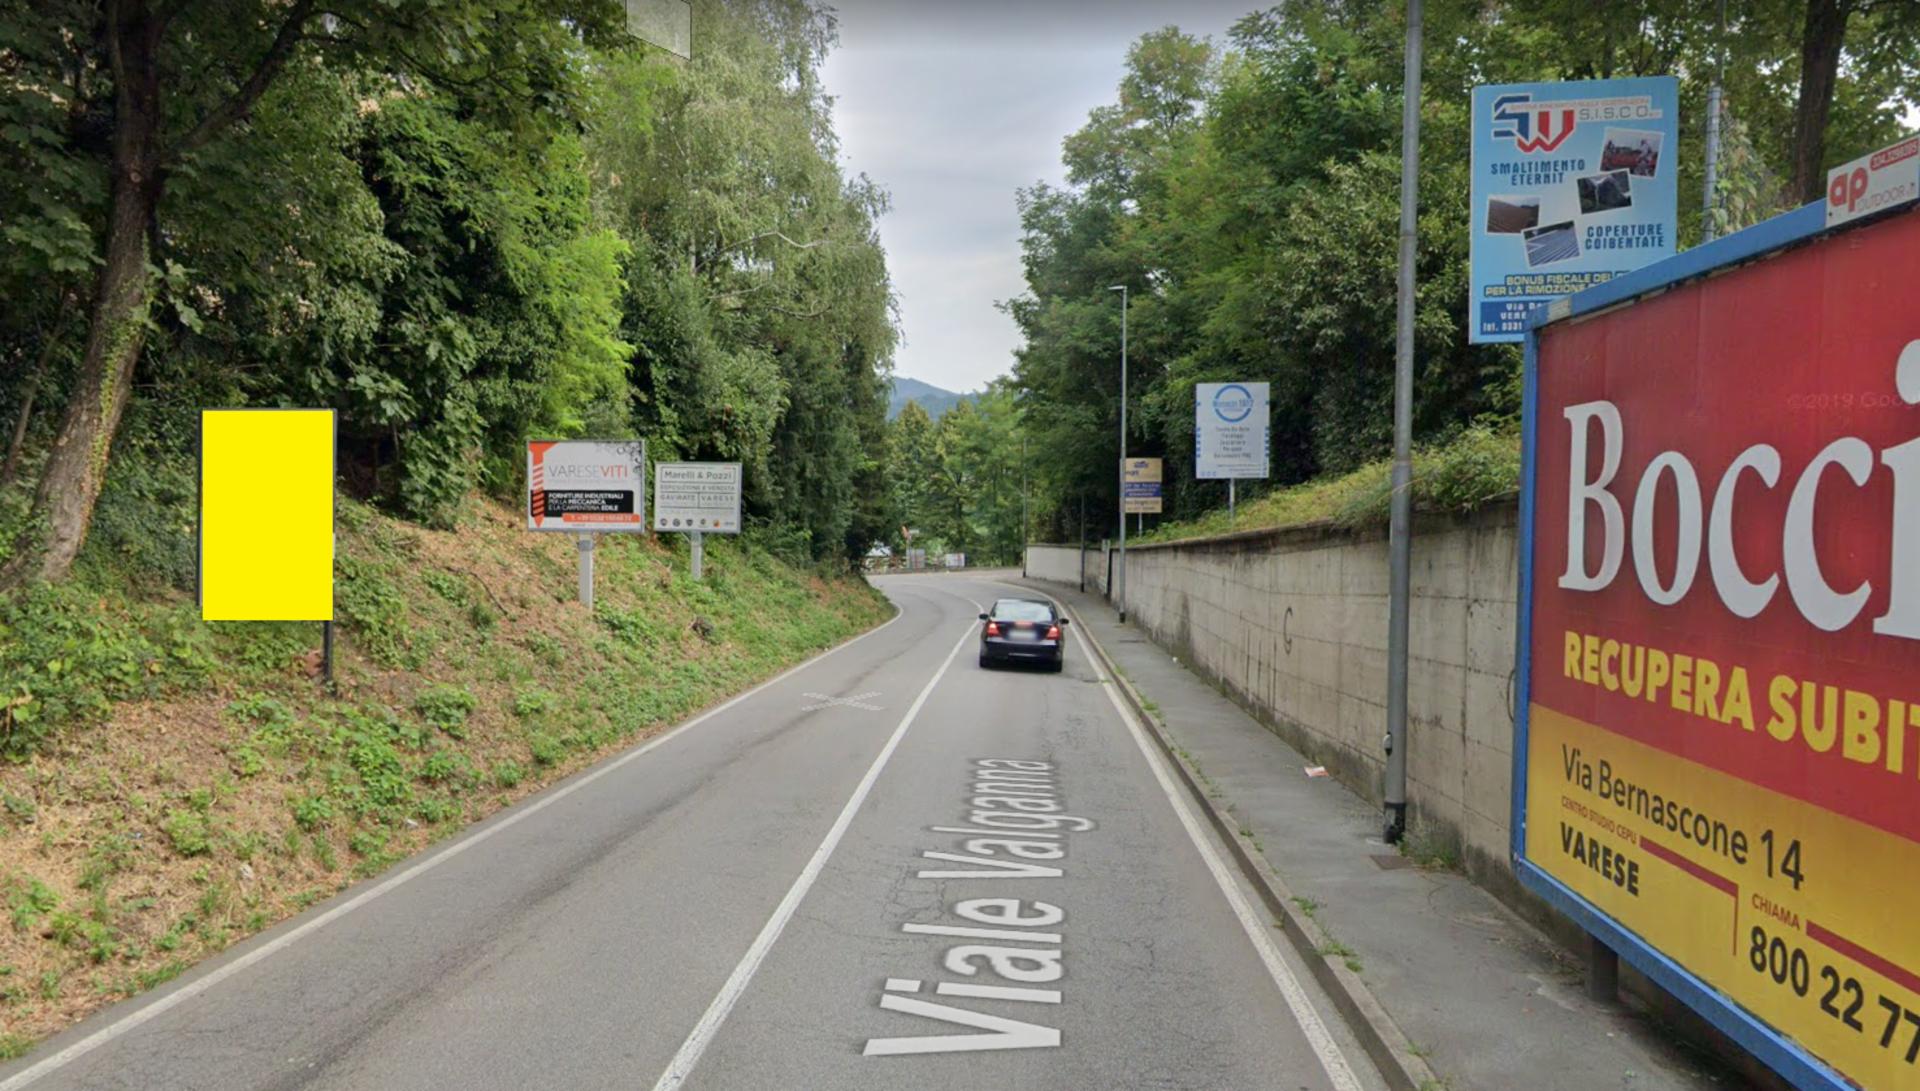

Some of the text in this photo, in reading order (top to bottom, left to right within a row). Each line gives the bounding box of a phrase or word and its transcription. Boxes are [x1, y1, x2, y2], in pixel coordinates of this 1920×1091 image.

[1490, 158, 1586, 175] SMALTIMENTO
[1511, 172, 1565, 187] ETERNIT
[1586, 223, 1664, 238] COPERTURE
[1585, 236, 1665, 250] COIBENTATE
[1506, 275, 1544, 286] BONUS
[1546, 273, 1591, 285] FISCALE
[1485, 286, 1506, 296] PER
[1508, 285, 1523, 295] LA
[664, 470, 732, 480] Marelli & Pozzi
[1564, 630, 1755, 732] RECUPERA
[1561, 796, 1637, 845] CENTRO STUDIO CEPU
[1562, 743, 1804, 891] Via Bernascone 14
[1560, 821, 1639, 898] VARESE
[1752, 892, 1801, 931] CHIAMA
[1750, 925, 1809, 998] 800
[1820, 964, 1863, 1033] 22
